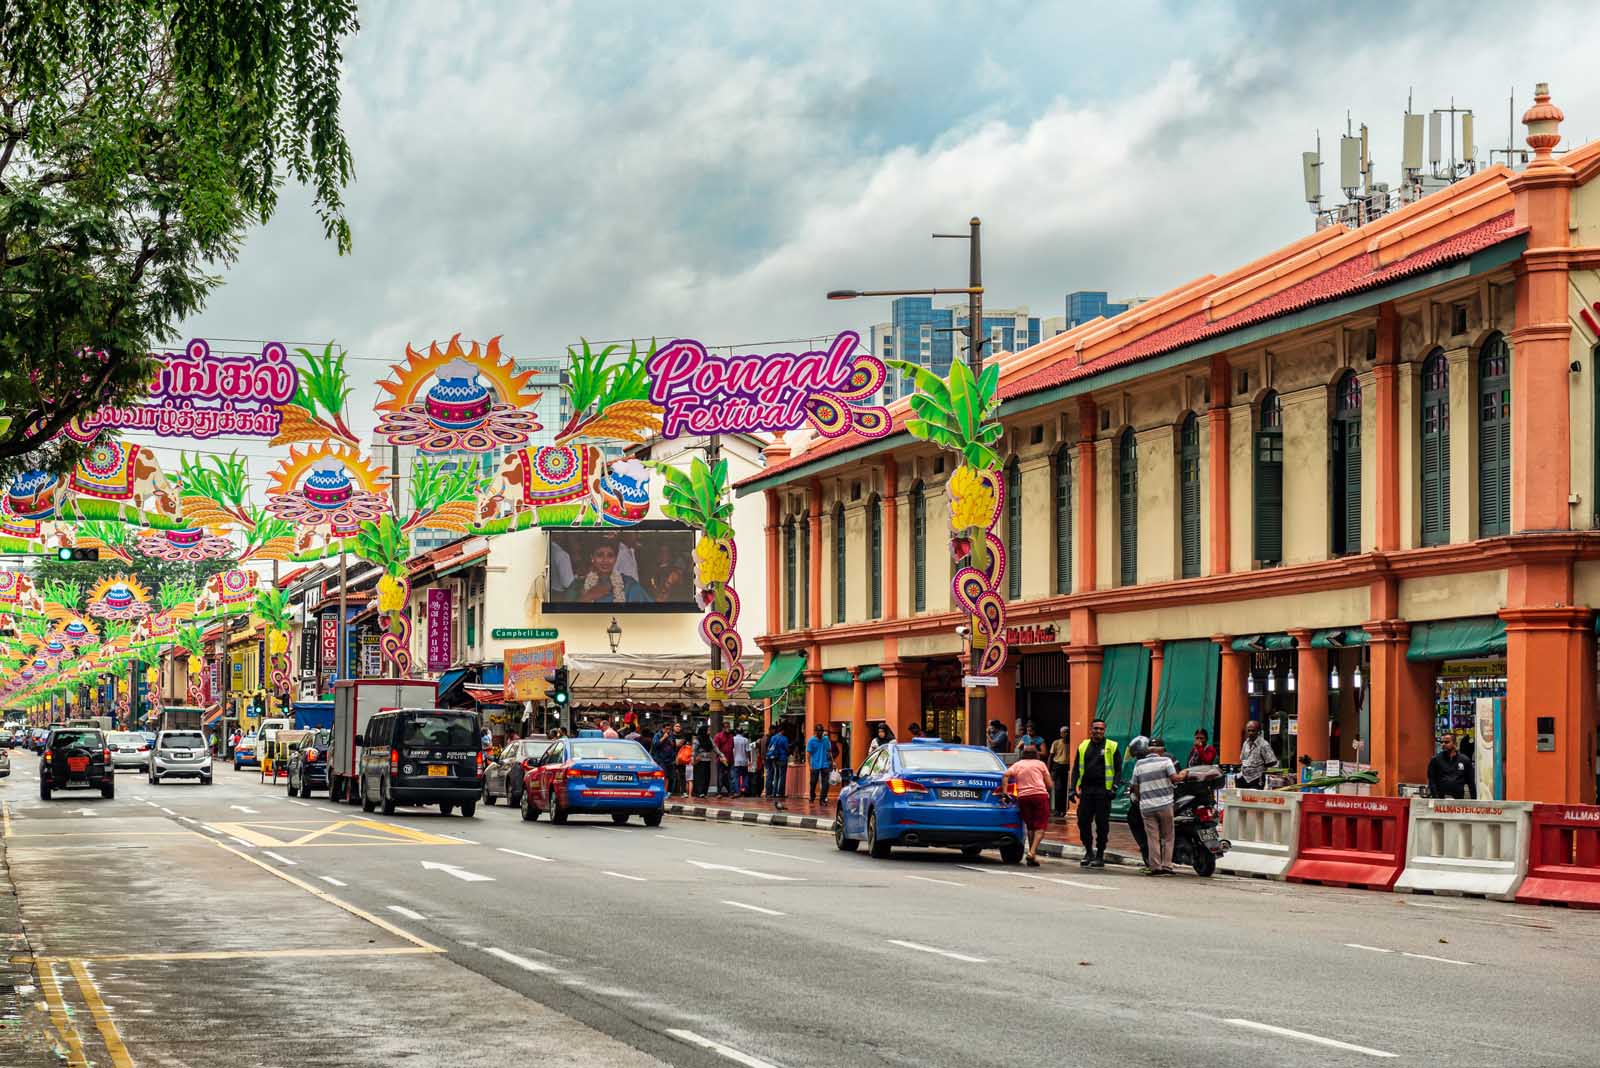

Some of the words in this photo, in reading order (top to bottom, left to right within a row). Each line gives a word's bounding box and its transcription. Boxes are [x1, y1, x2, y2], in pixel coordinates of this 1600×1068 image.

[651, 332, 858, 404] Pongal
[665, 390, 805, 438] Festival
[324, 629, 336, 658] MGR
[495, 629, 533, 637] Campbell
[535, 629, 555, 637] Lane
